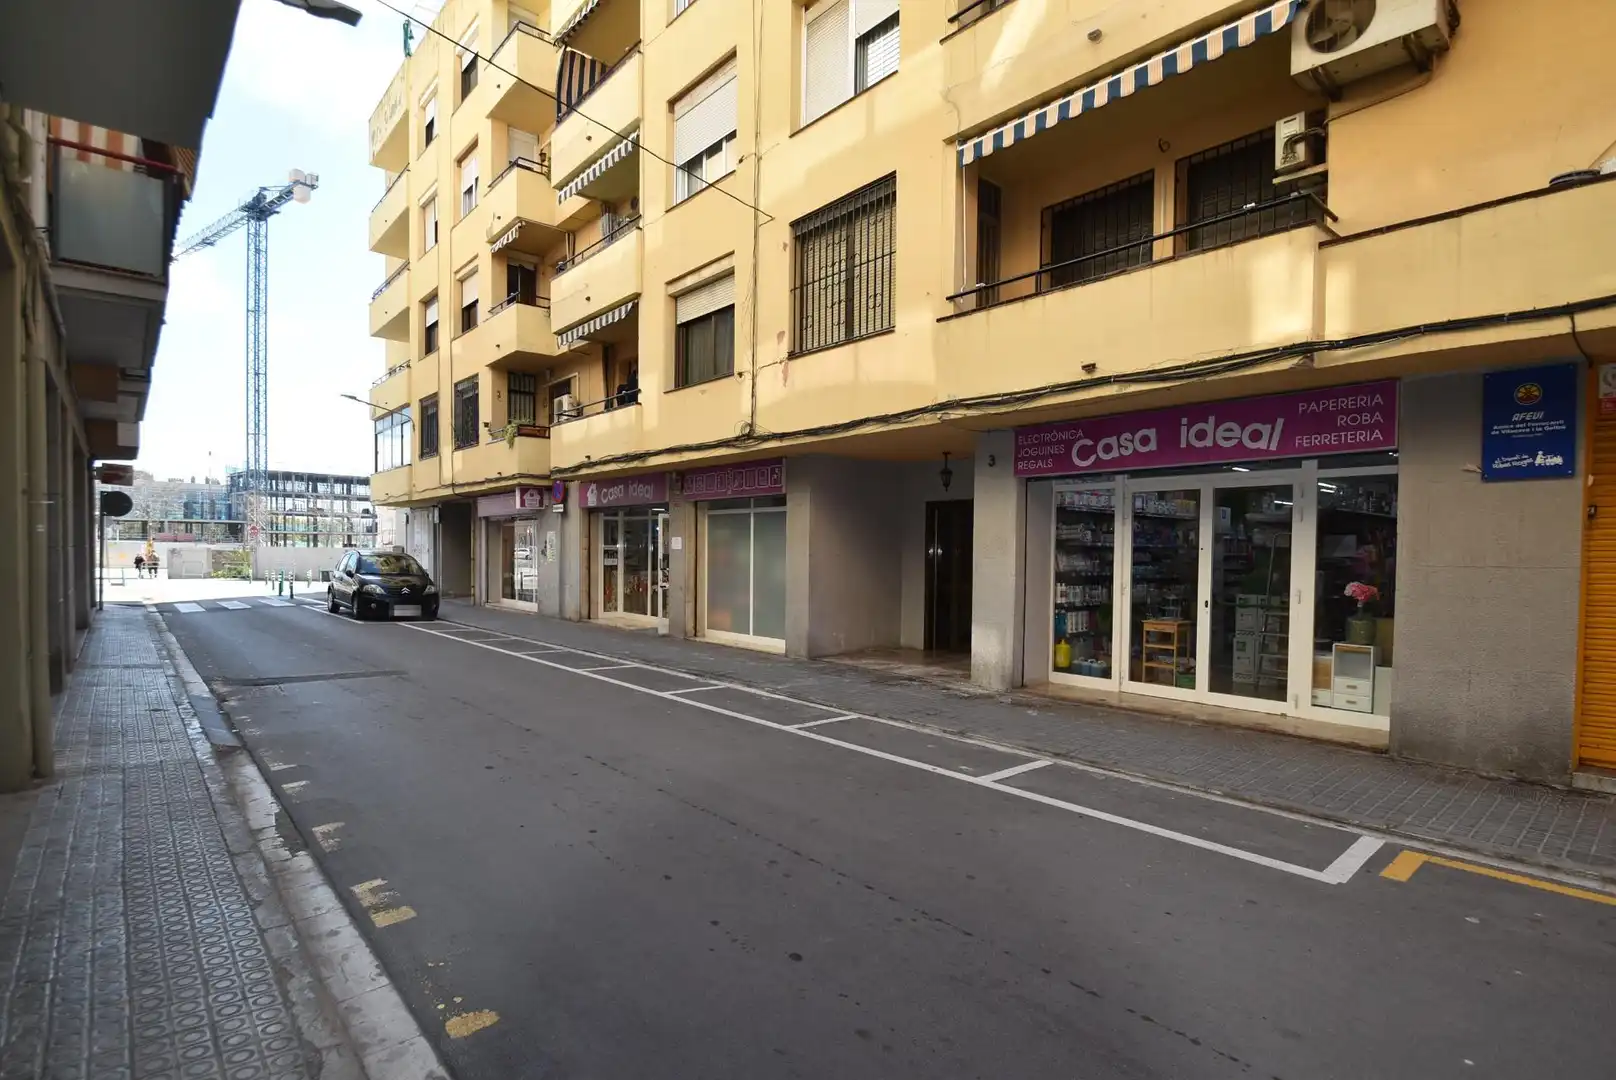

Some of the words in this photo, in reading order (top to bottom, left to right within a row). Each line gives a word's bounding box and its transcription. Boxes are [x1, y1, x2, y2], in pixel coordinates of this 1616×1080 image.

[1298, 394, 1384, 415] PAPERERIA
[1337, 411, 1384, 427] ROBA
[1071, 428, 1158, 467] Casa
[1180, 415, 1285, 451] ideal
[1295, 429, 1384, 448] FERRETERIA
[1017, 444, 1065, 458] JOGUINES
[987, 454, 997, 467] 3
[1017, 459, 1054, 471] REGALS
[628, 479, 654, 500] ideal
